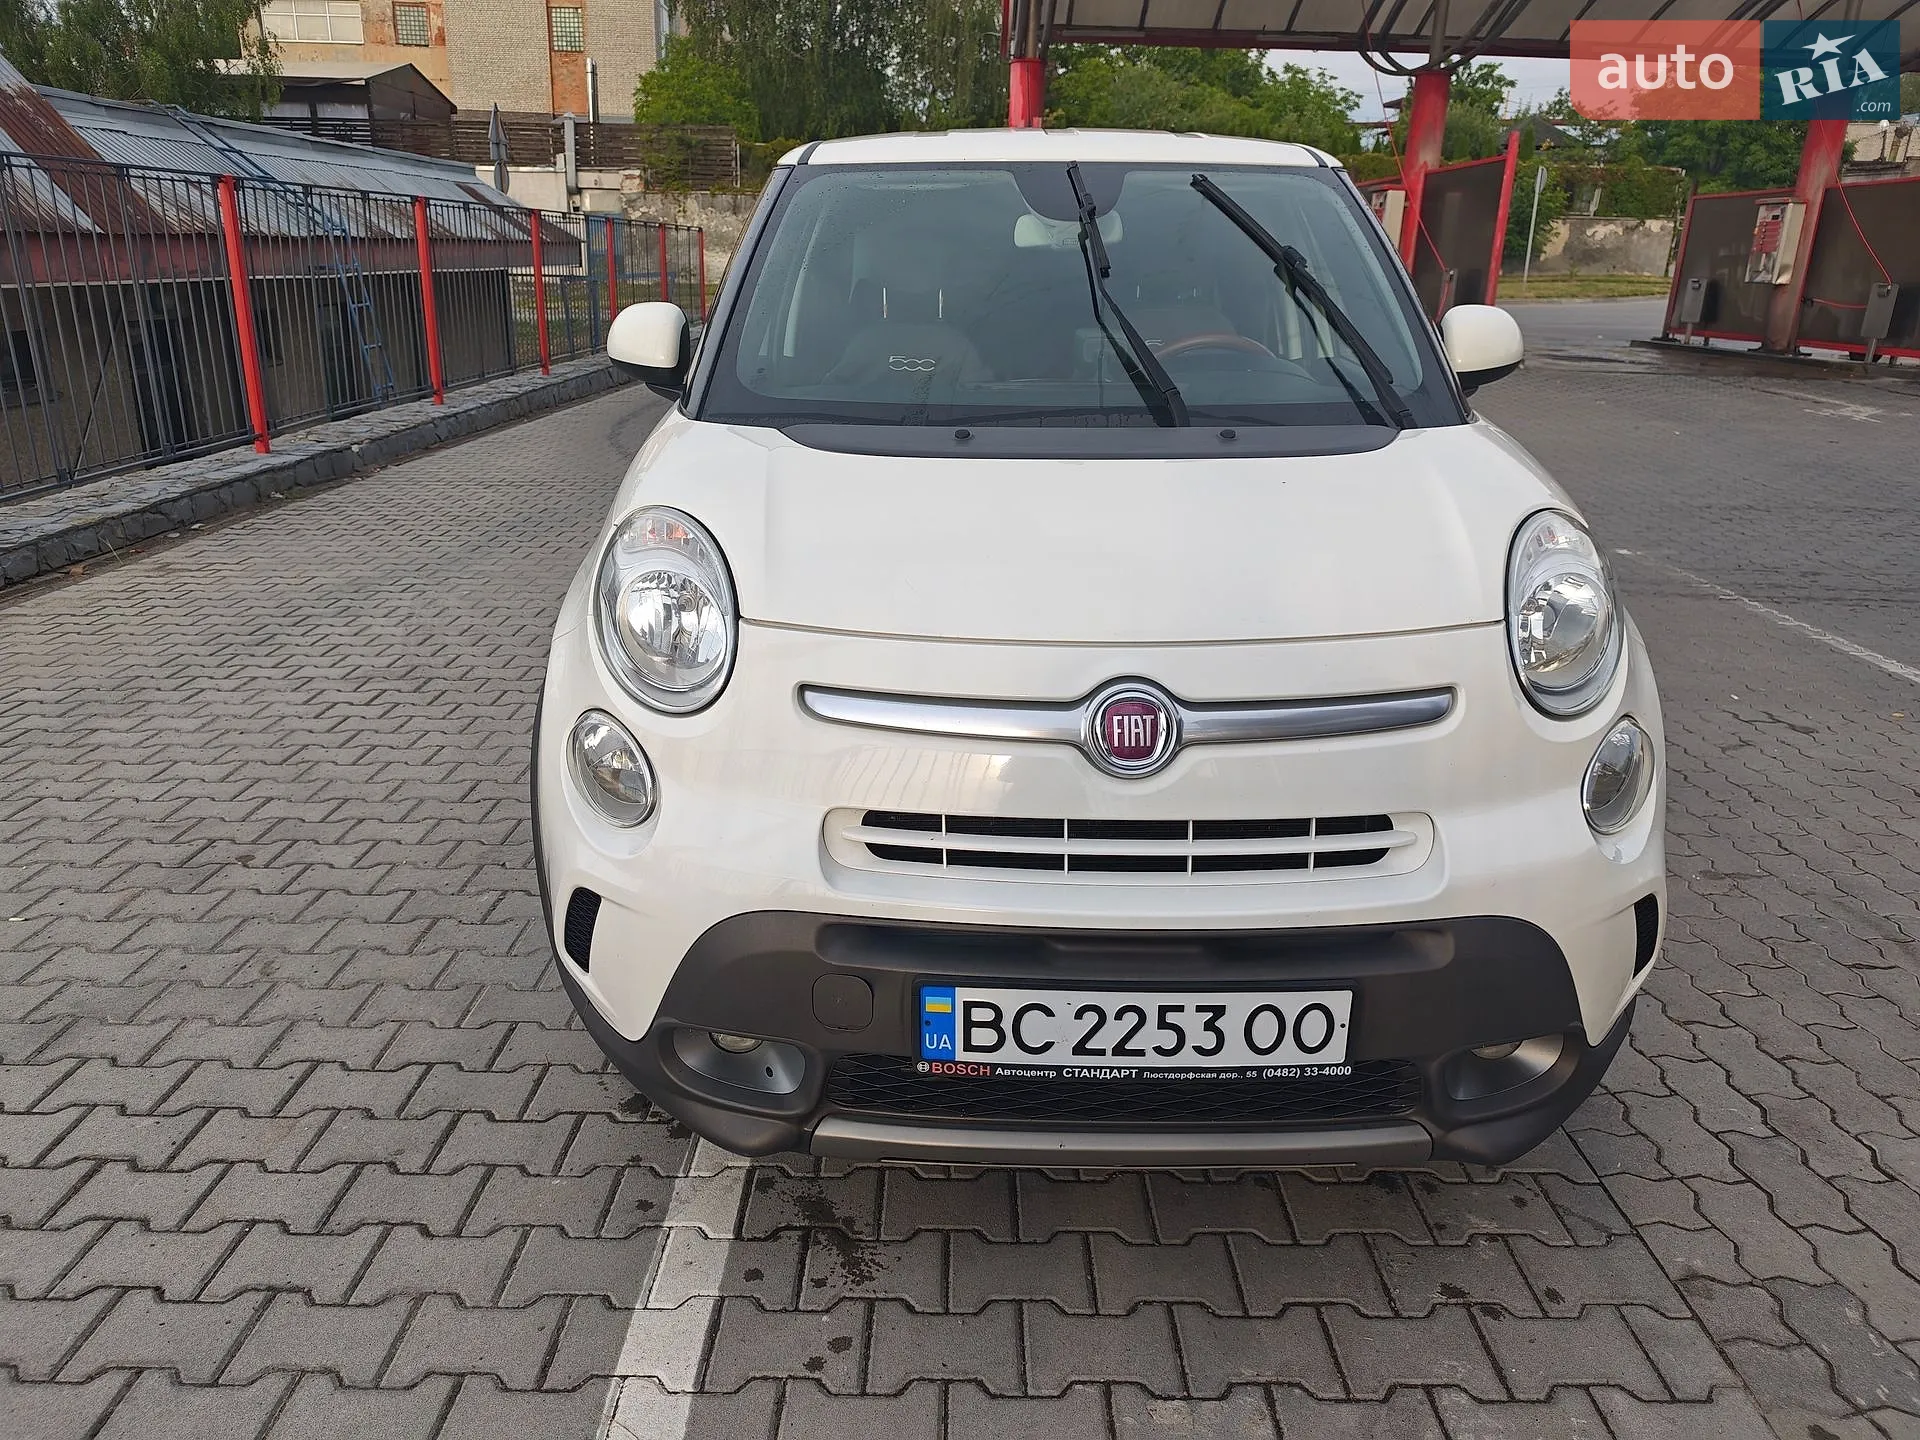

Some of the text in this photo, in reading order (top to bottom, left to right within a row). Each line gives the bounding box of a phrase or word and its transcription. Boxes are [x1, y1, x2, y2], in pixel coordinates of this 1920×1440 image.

[1112, 714, 1155, 748] FIAT
[962, 999, 1056, 1056] BC
[1071, 1003, 1226, 1058] 2253
[925, 1033, 952, 1051] UA
[931, 1062, 991, 1077] BOSCH
[995, 1067, 1057, 1079] Автоцентр
[1062, 1067, 1139, 1080] СТАНДАРТ
[1143, 1070, 1217, 1080] Люстдорфская
[1245, 1070, 1258, 1079] 55
[1262, 1067, 1301, 1080] (0482)
[1303, 1065, 1352, 1077] 33-4000
